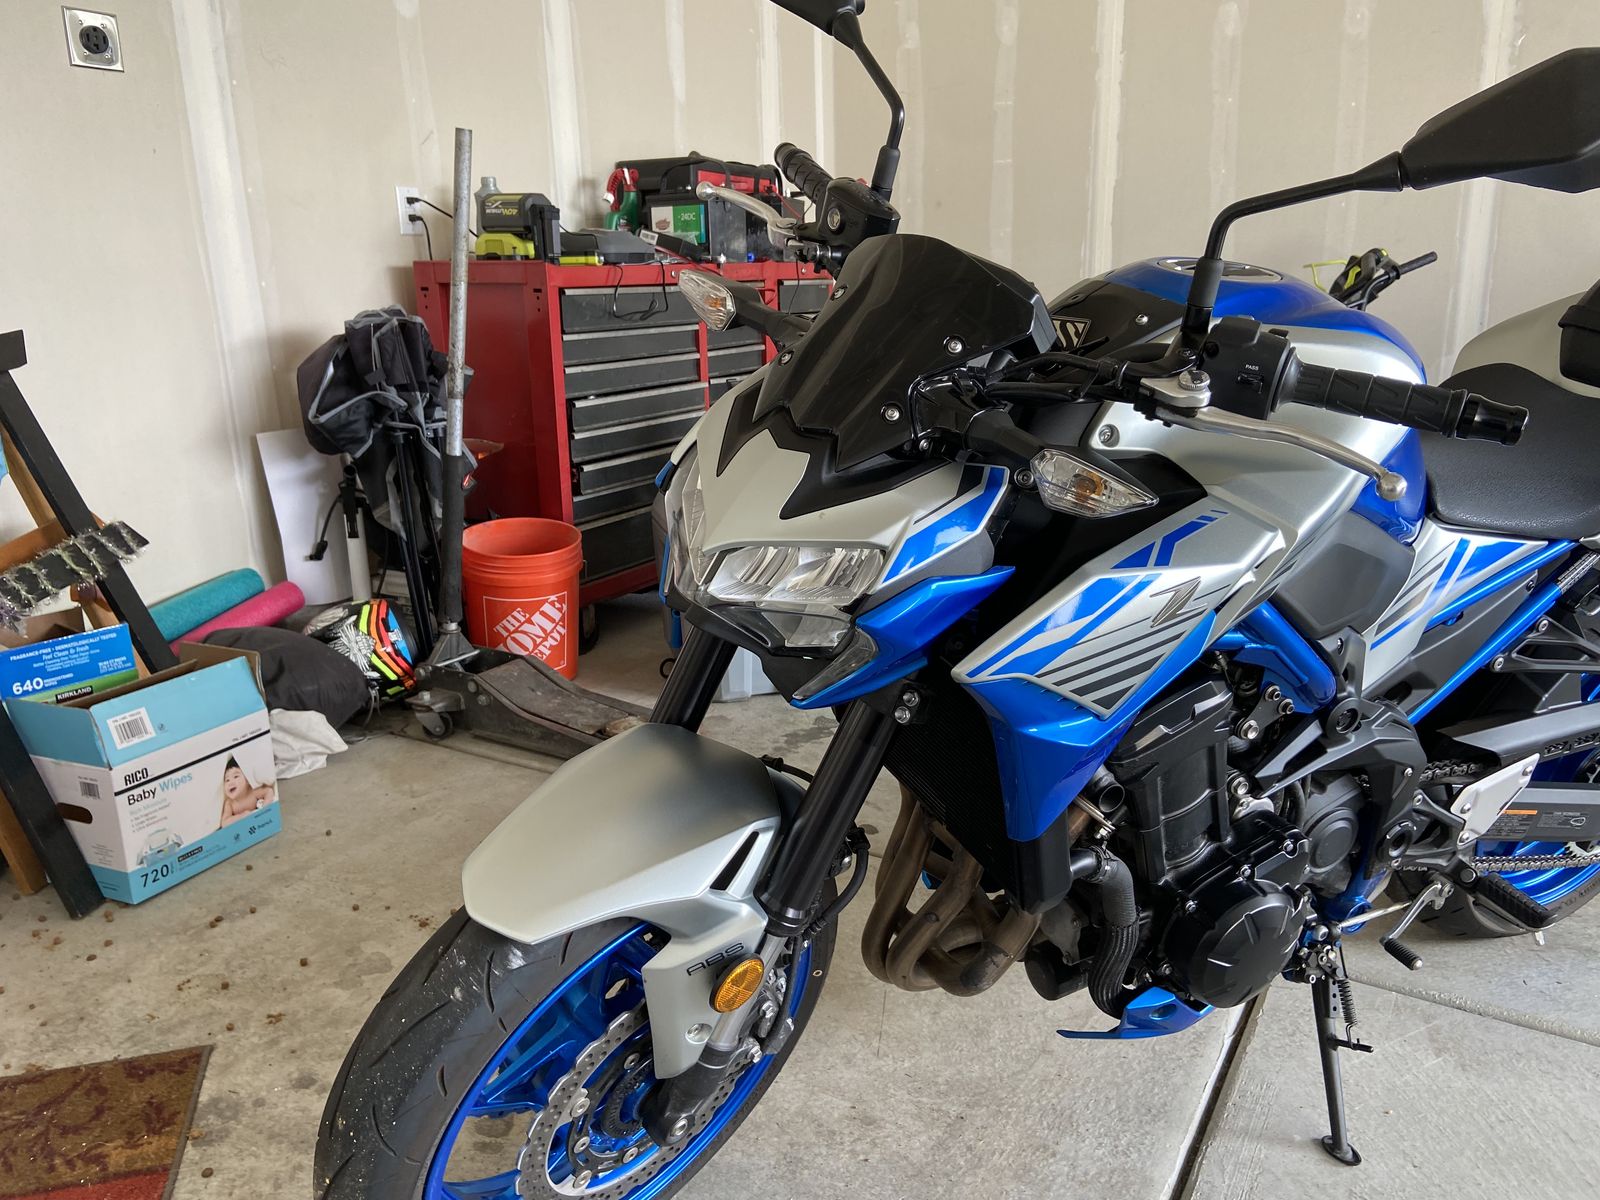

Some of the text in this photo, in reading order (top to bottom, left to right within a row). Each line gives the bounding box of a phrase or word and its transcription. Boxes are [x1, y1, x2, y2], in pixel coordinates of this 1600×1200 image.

[494, 608, 530, 638] THE
[532, 622, 567, 661] EPOT
[12, 677, 44, 695] 640
[57, 686, 92, 700] KIRKLAND
[124, 767, 149, 787] RICO
[127, 772, 193, 806] Baby Wipes
[140, 864, 170, 888] 720
[686, 942, 744, 976] ABS
